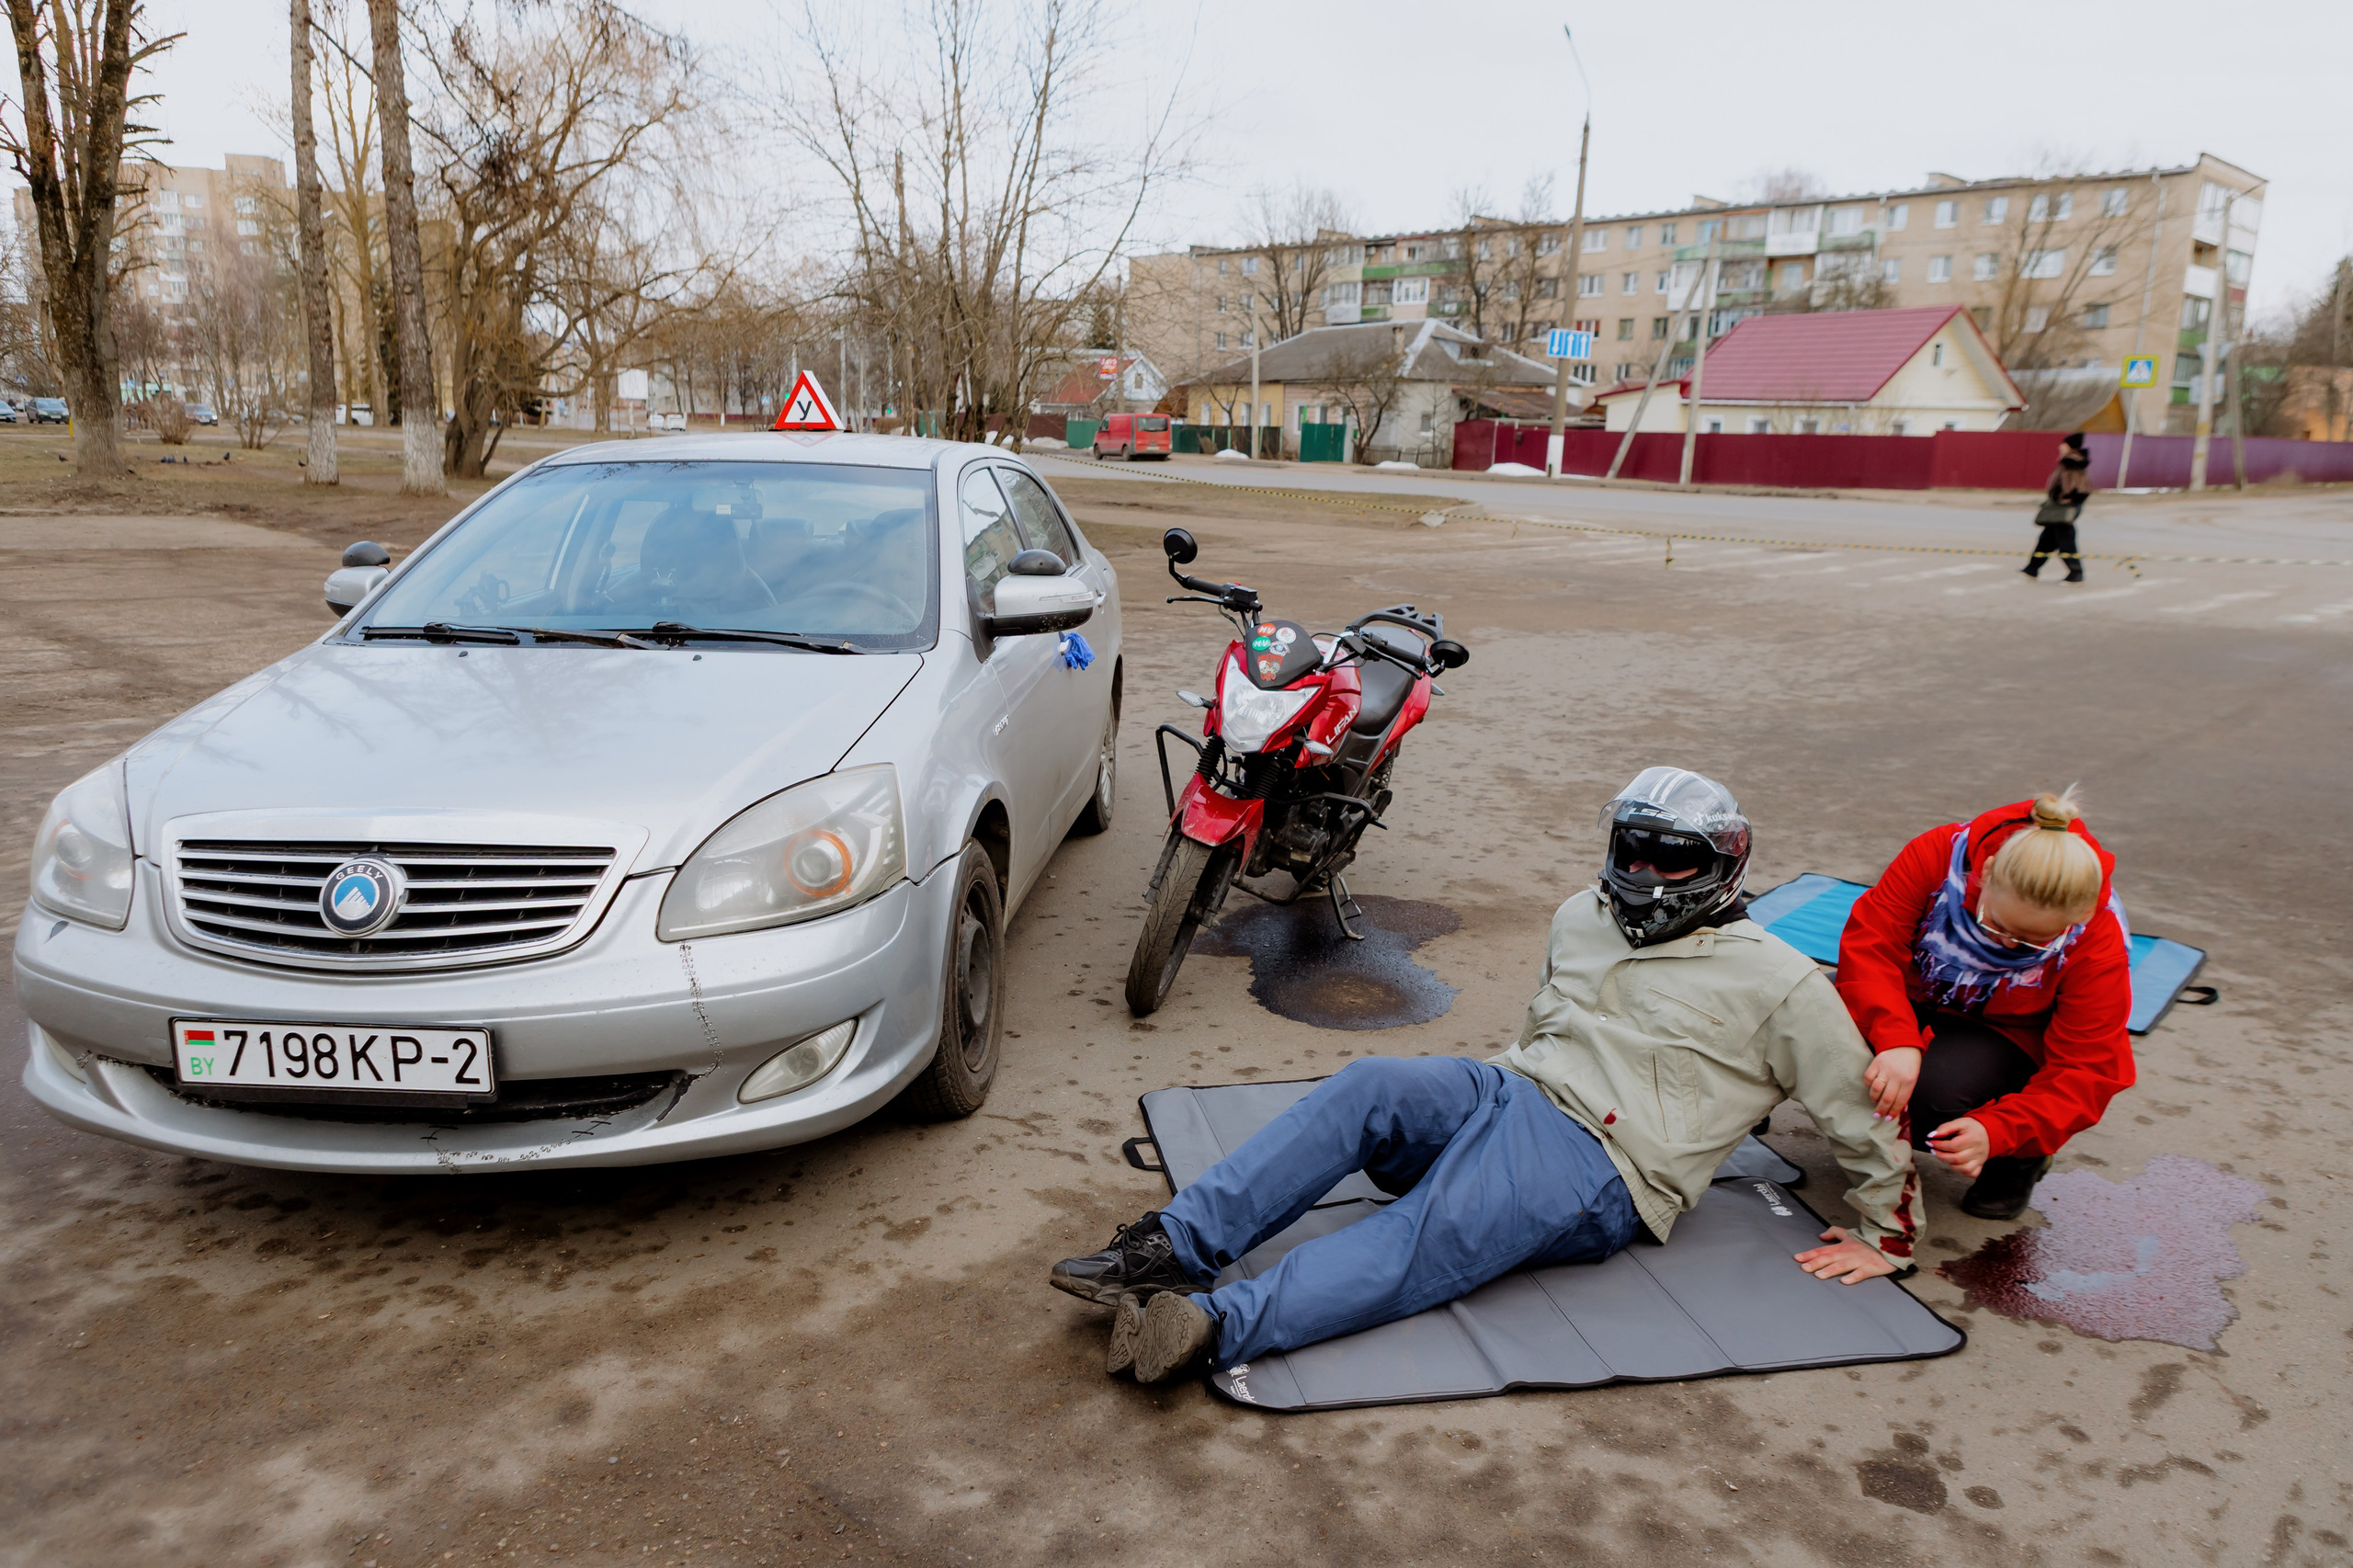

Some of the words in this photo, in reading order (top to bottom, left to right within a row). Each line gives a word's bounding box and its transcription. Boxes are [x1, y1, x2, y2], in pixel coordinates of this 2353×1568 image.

[1325, 704, 1358, 744] LIFAN
[1628, 808, 1678, 823] LS2
[335, 865, 383, 881] GEELY
[190, 1057, 215, 1075] BY
